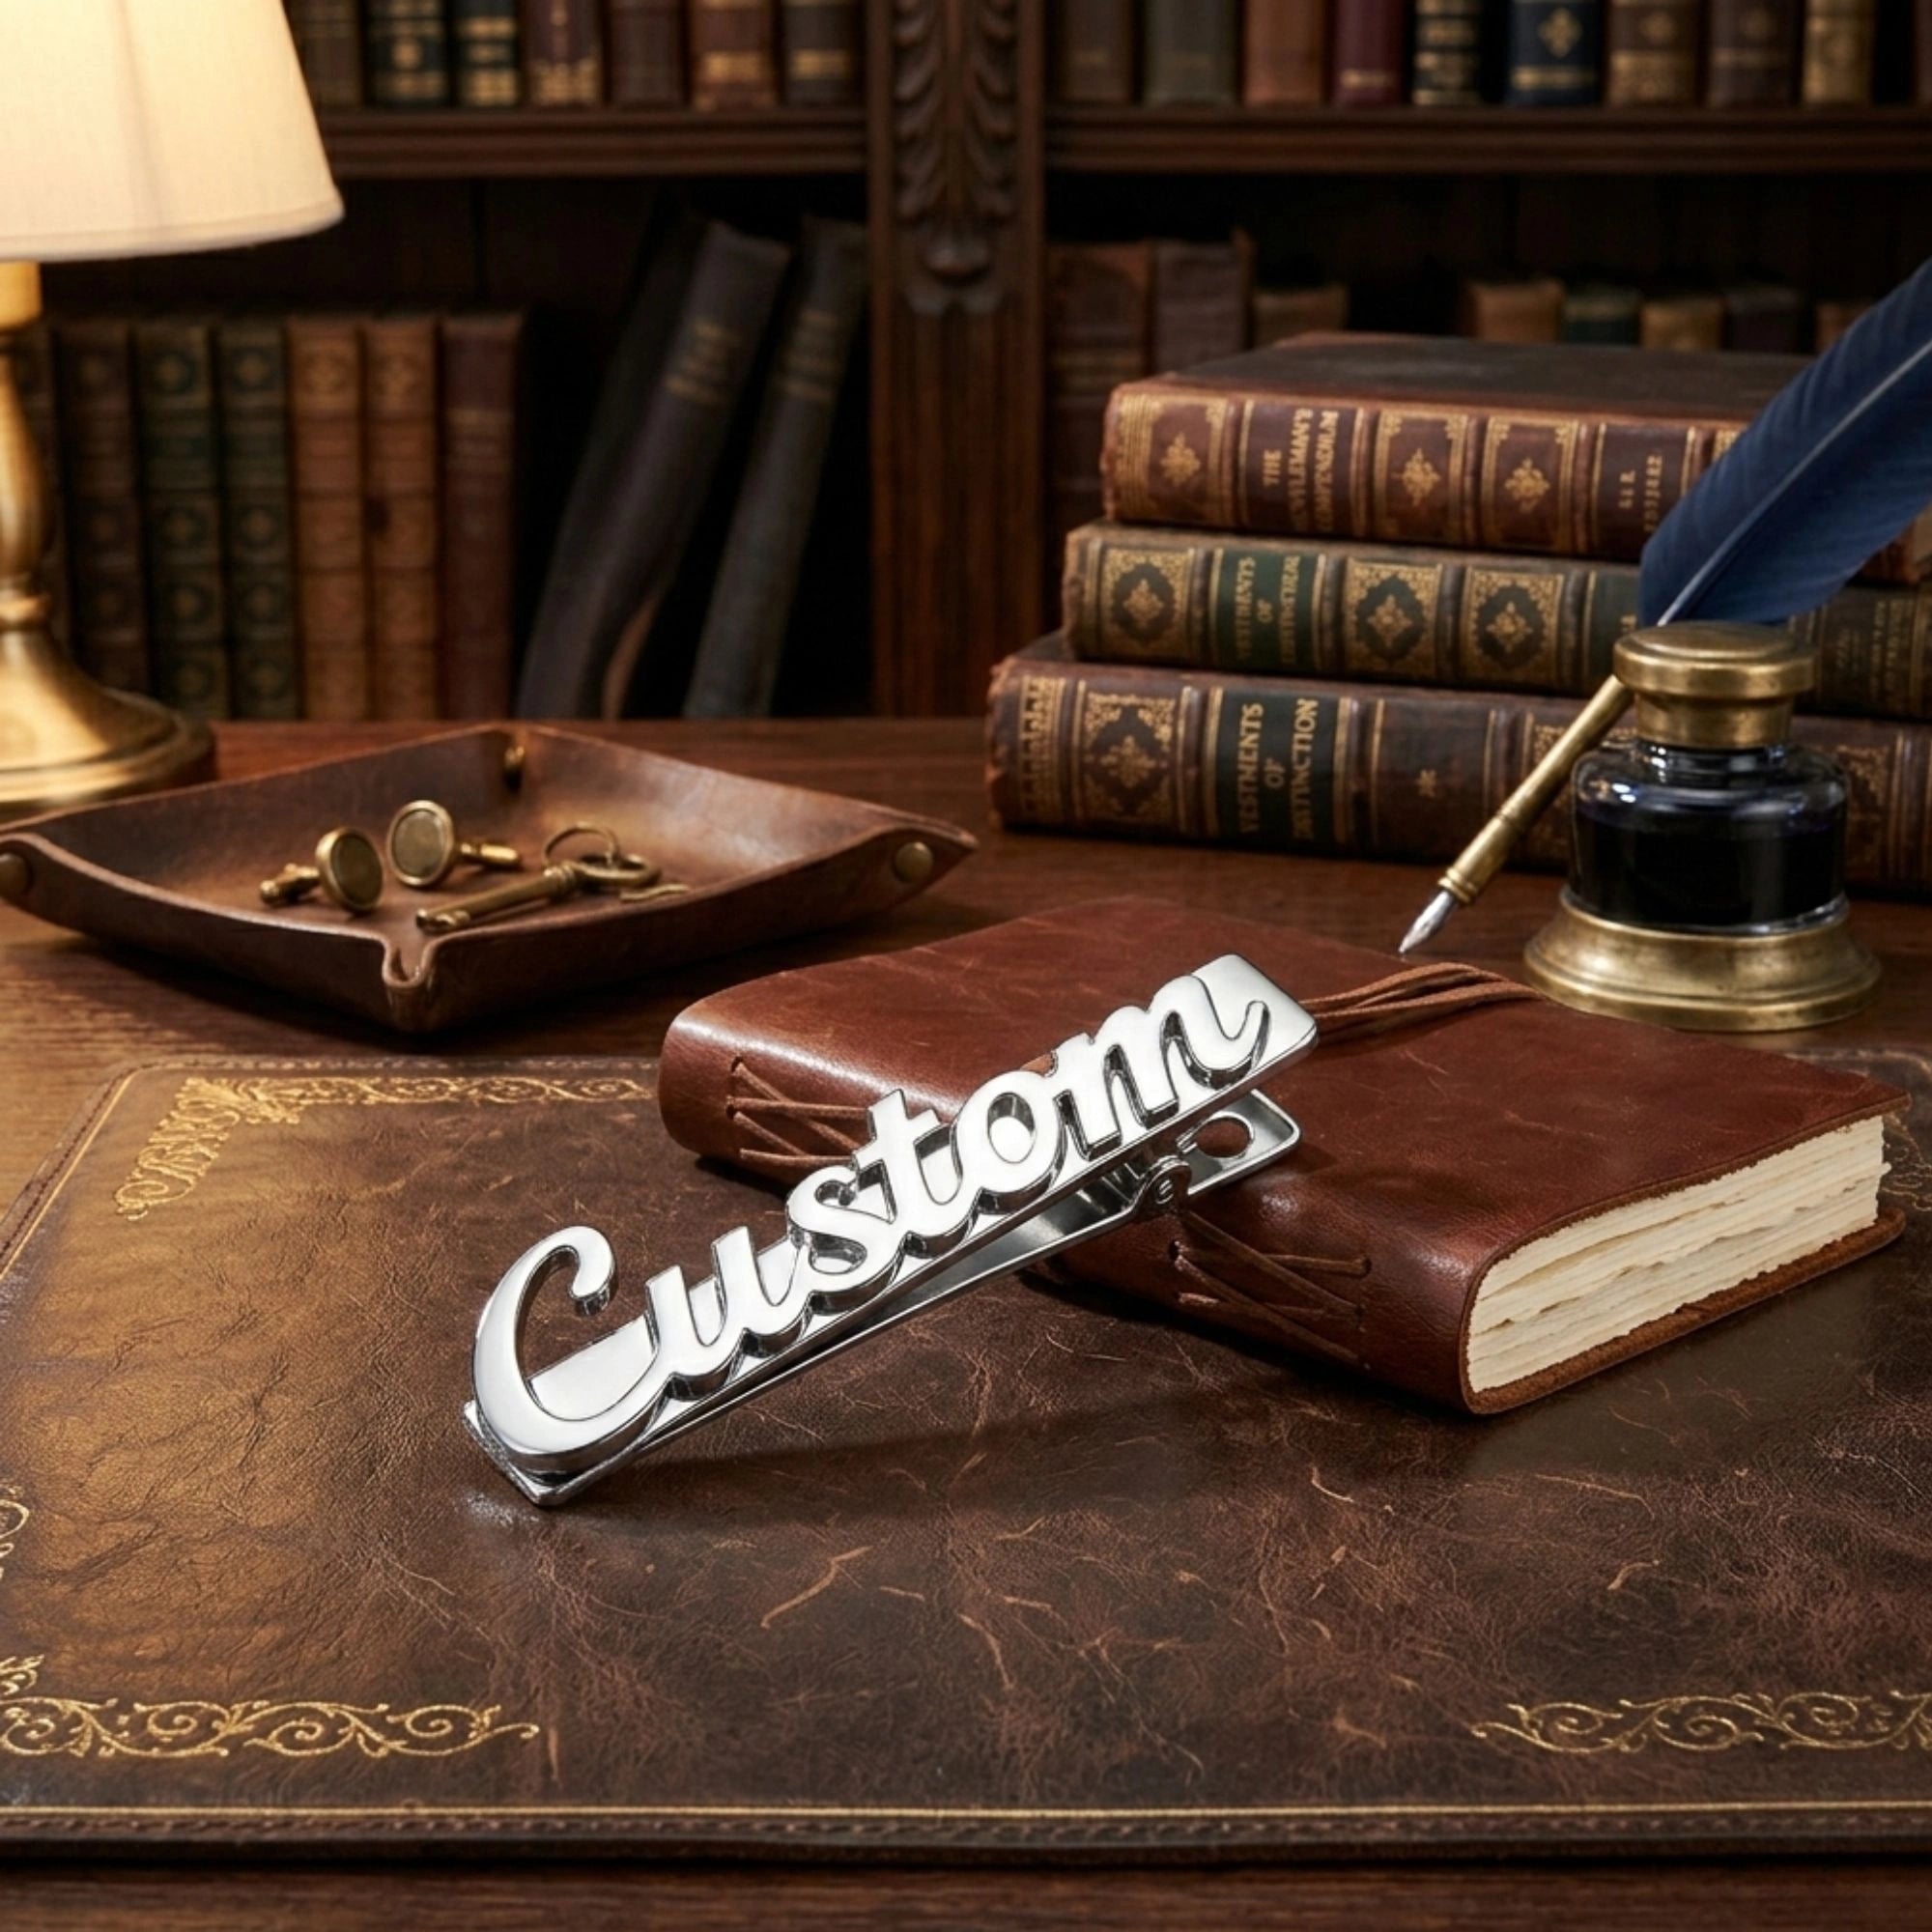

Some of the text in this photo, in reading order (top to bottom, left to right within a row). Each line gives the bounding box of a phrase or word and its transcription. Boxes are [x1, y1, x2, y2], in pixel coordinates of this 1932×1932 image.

[1263, 448, 1282, 487] THE
[1237, 702, 1264, 834] VESTMENTS
[1264, 757, 1286, 788] OF
[1292, 698, 1319, 840] DISTINCTION
[471, 974, 1272, 1474] Custom
